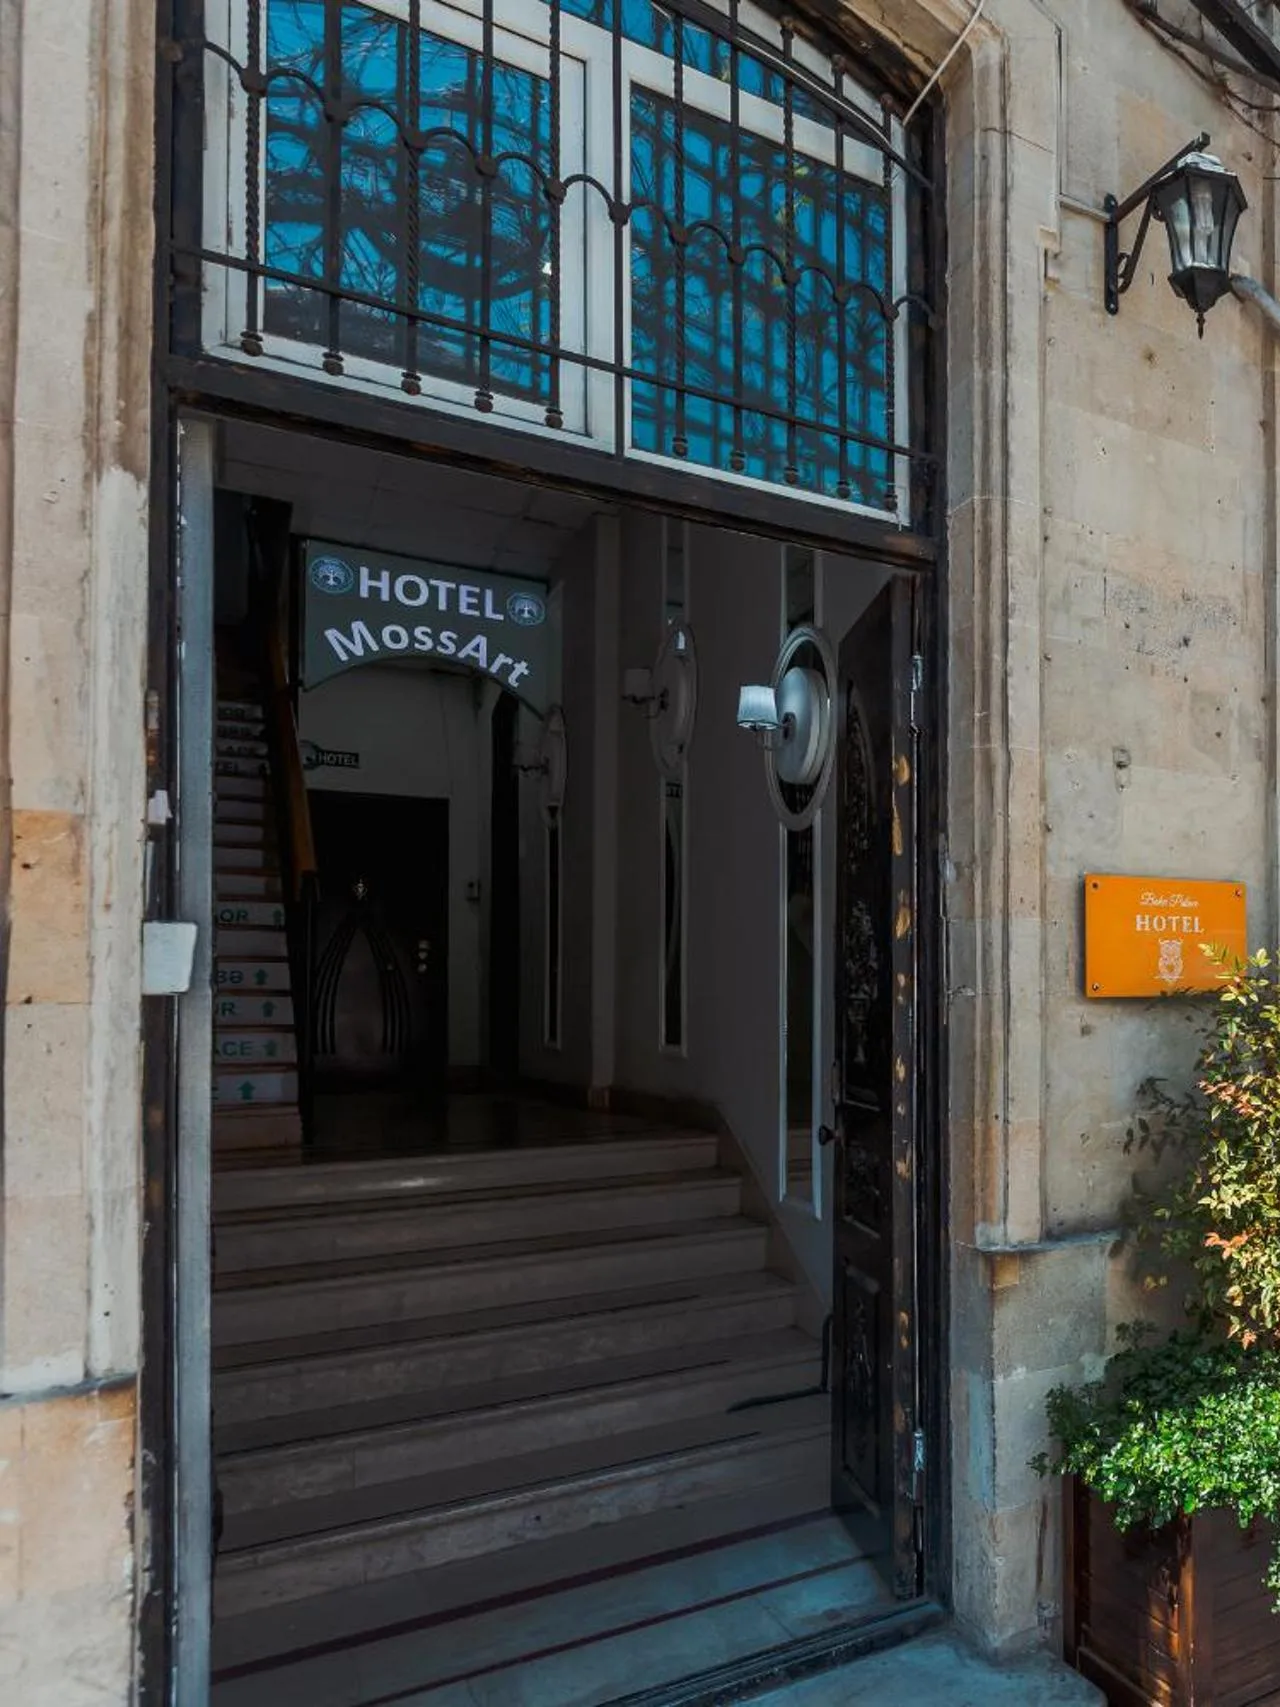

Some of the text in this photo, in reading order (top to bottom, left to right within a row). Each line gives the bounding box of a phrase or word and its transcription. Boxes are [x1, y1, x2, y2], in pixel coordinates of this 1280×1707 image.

[358, 565, 505, 621] HOTEL
[324, 620, 532, 689] MossArt
[317, 751, 358, 766] HOTEL
[1135, 914, 1204, 933] HOTEL
